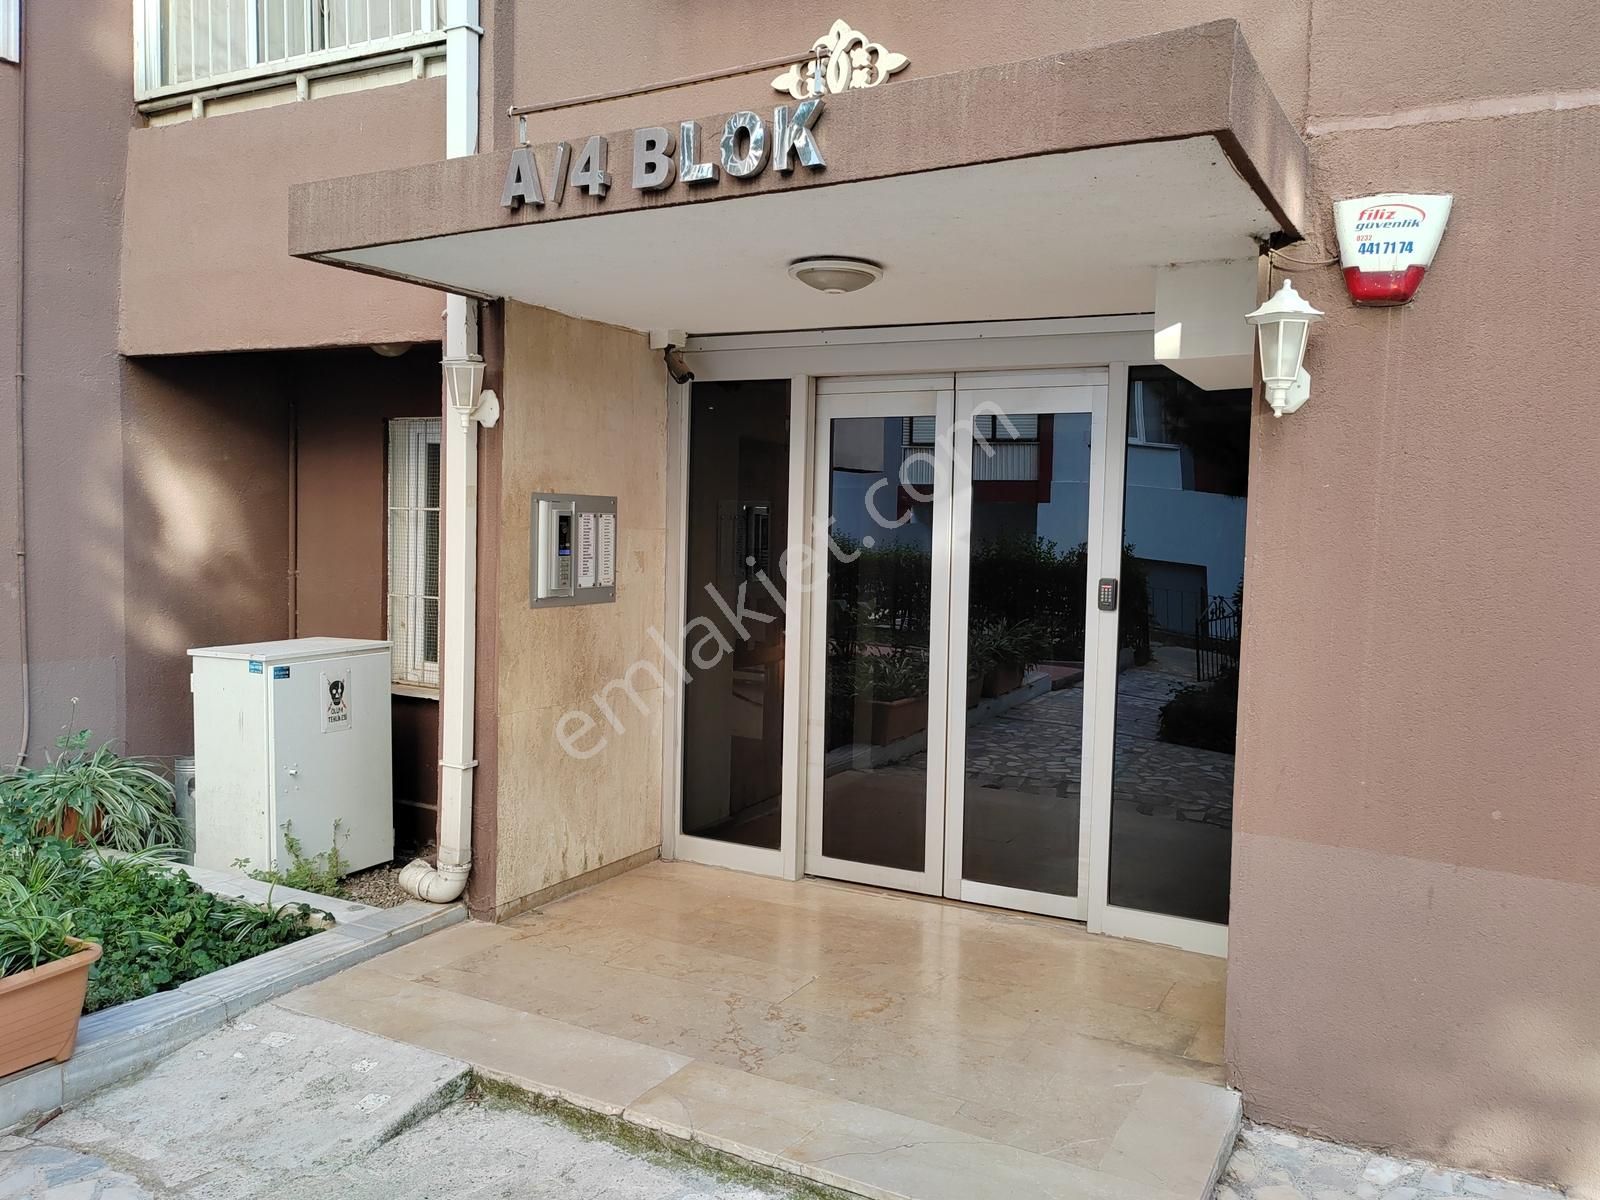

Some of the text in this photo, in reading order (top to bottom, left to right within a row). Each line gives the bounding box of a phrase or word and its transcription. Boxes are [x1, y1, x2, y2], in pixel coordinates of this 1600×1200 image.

[501, 99, 827, 208] A/4 BLOK
[1358, 208, 1397, 221] filiz
[1355, 219, 1420, 232] güvenlik
